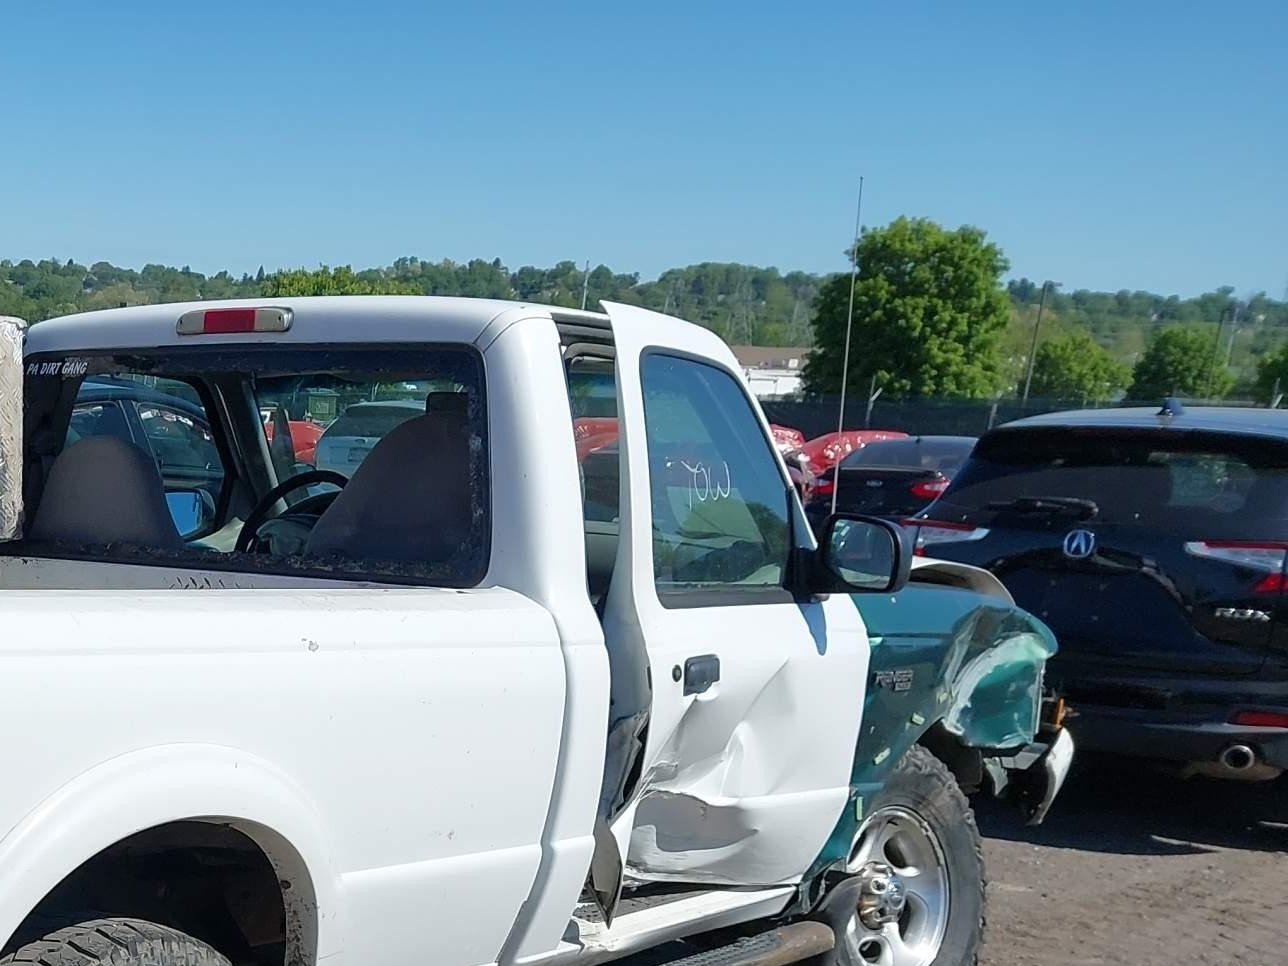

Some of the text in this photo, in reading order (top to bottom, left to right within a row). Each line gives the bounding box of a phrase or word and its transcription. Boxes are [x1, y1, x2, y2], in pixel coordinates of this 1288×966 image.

[27, 361, 88, 375] PA DIRT GANG
[669, 460, 731, 511] TOW
